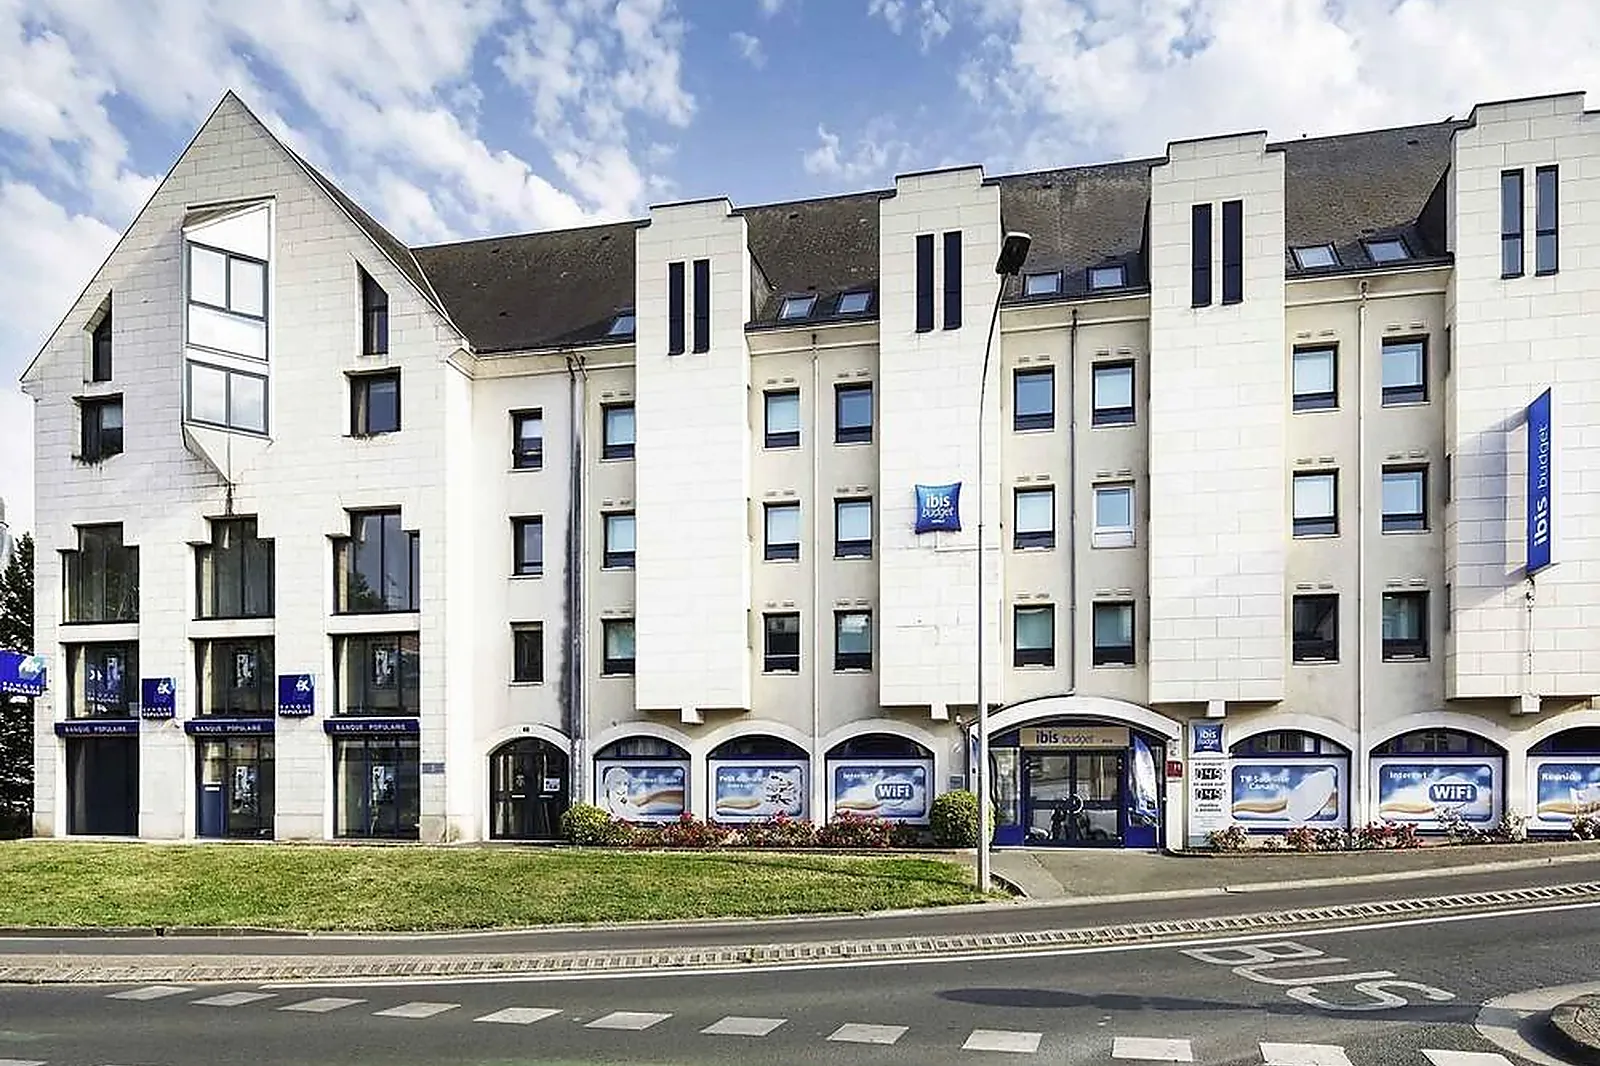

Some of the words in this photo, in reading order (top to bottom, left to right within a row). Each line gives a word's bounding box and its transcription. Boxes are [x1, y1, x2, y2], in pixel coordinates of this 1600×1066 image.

[1538, 423, 1549, 490] budget
[926, 493, 950, 507] ibis
[921, 507, 954, 519] budget
[1534, 496, 1548, 546] ibis
[195, 724, 222, 733] BANQUE
[226, 723, 262, 732] POPULAIRE
[335, 723, 364, 731] BANQUE
[368, 723, 406, 731] POPULAIRE
[1036, 730, 1059, 744] ibis
[1061, 733, 1094, 748] budget
[1200, 729, 1217, 739] ibis
[1389, 771, 1427, 779] Internet
[878, 785, 910, 798] WiFi
[1433, 785, 1472, 799] WiFi
[1184, 941, 1456, 1010] BUS
